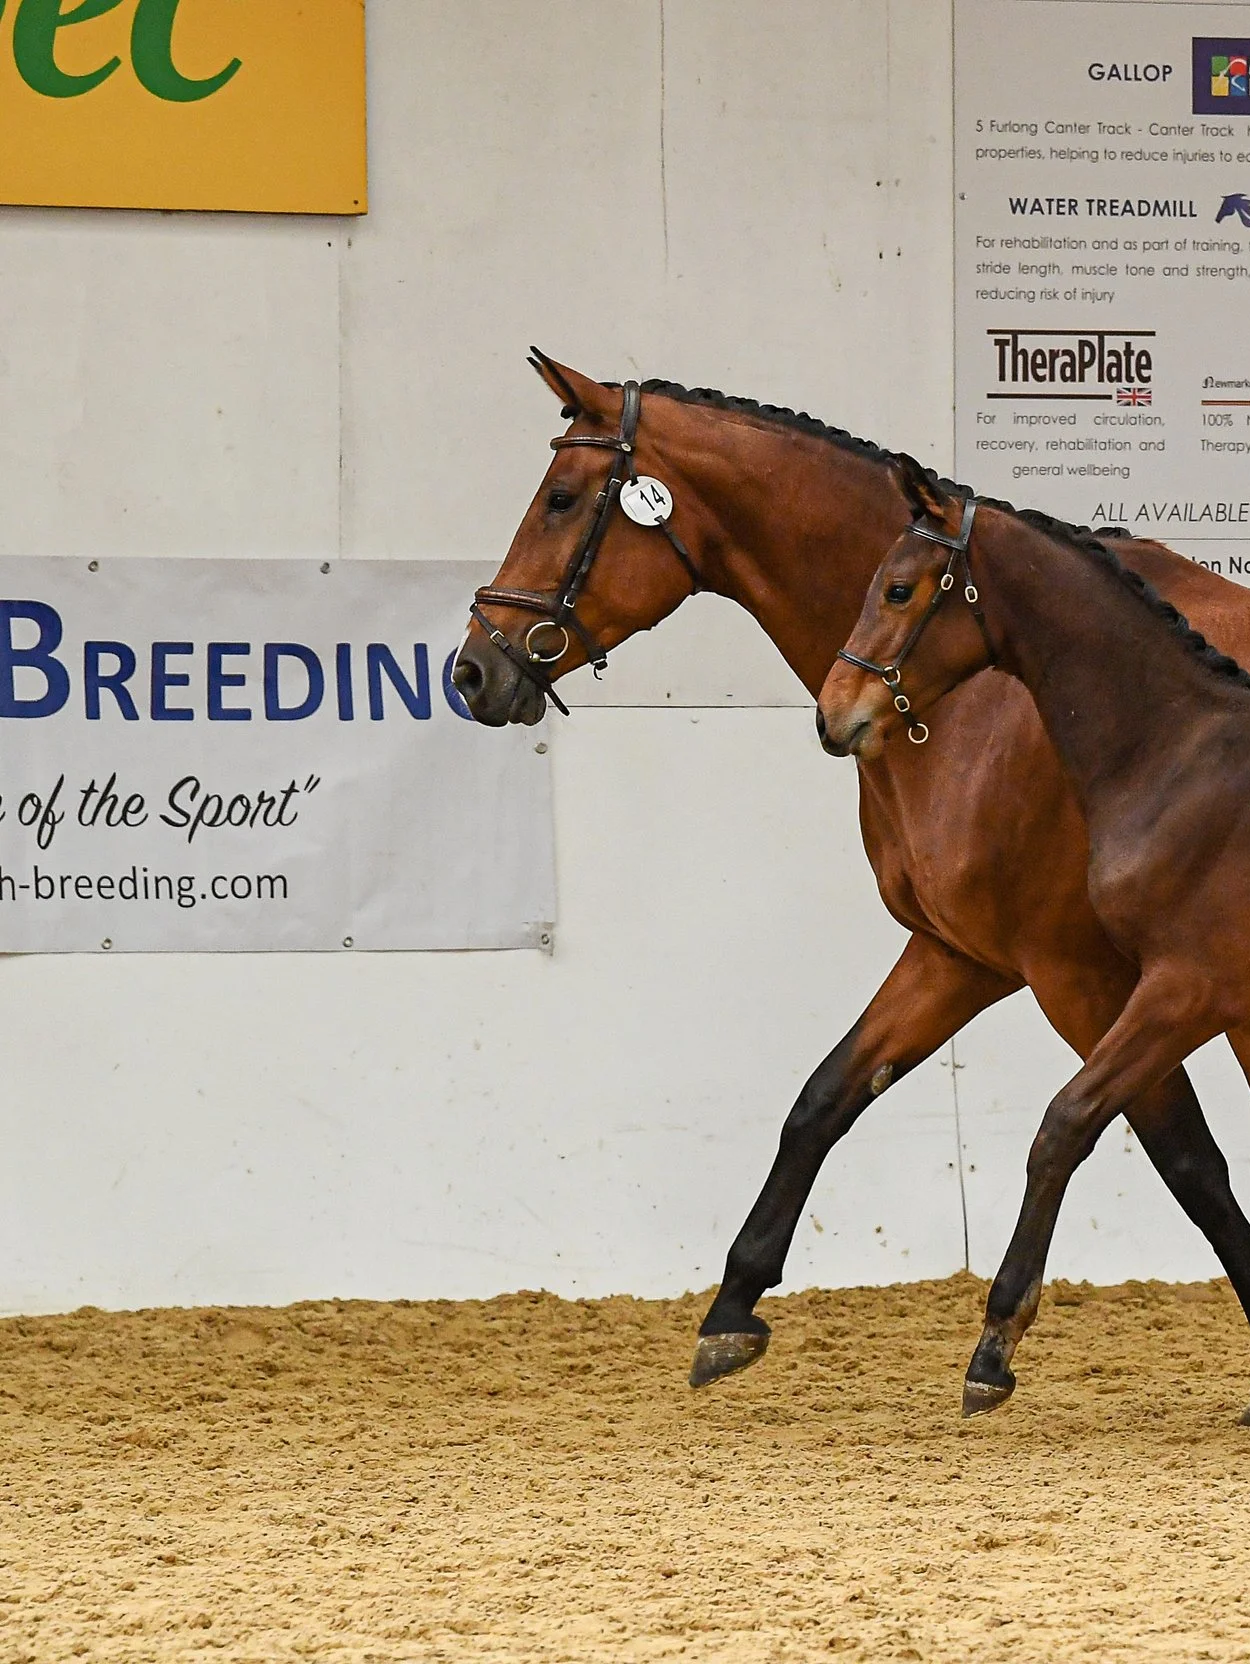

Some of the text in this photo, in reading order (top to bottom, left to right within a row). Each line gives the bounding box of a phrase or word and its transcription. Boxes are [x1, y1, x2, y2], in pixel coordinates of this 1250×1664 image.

[1088, 63, 1172, 81] GALLOP
[976, 120, 983, 132] 5
[990, 120, 1038, 136] Furlong
[1045, 121, 1090, 134] Canter
[1097, 122, 1131, 135] Track
[1149, 123, 1194, 136] Canter
[1201, 124, 1234, 137] Track
[976, 146, 1045, 162] properties,
[1050, 147, 1099, 163] helping
[1104, 148, 1117, 160] to
[1121, 149, 1168, 161] reduce
[1173, 149, 1215, 164] injuries
[1220, 151, 1232, 162] to
[1009, 198, 1197, 217] WATER TREADMILL
[976, 236, 995, 248] For
[1001, 237, 1086, 249] rehabilitation
[1092, 238, 1118, 250] and
[1124, 241, 1137, 250] as
[1143, 240, 1168, 253] part
[1174, 239, 1187, 251] of
[1193, 239, 1243, 254] training,
[976, 261, 1011, 274] stride
[1019, 262, 1063, 277] length,
[1072, 264, 1117, 276] muscle
[1126, 264, 1155, 276] tone
[1163, 265, 1188, 276] and
[1196, 265, 1250, 280] strength,
[976, 288, 1115, 303] reducing risk of injury
[994, 337, 1152, 383] TheraPlate
[977, 412, 1164, 426] For improved circulation,
[1203, 414, 1233, 426] 100%
[977, 438, 1165, 455] recovery, rehabilitation and
[1012, 464, 1130, 479] general wellbeing
[640, 484, 666, 511] 14
[1092, 503, 1128, 521] ALL
[1135, 503, 1249, 522] AVAILABLE
[18, 774, 64, 850] of
[78, 772, 148, 827] the
